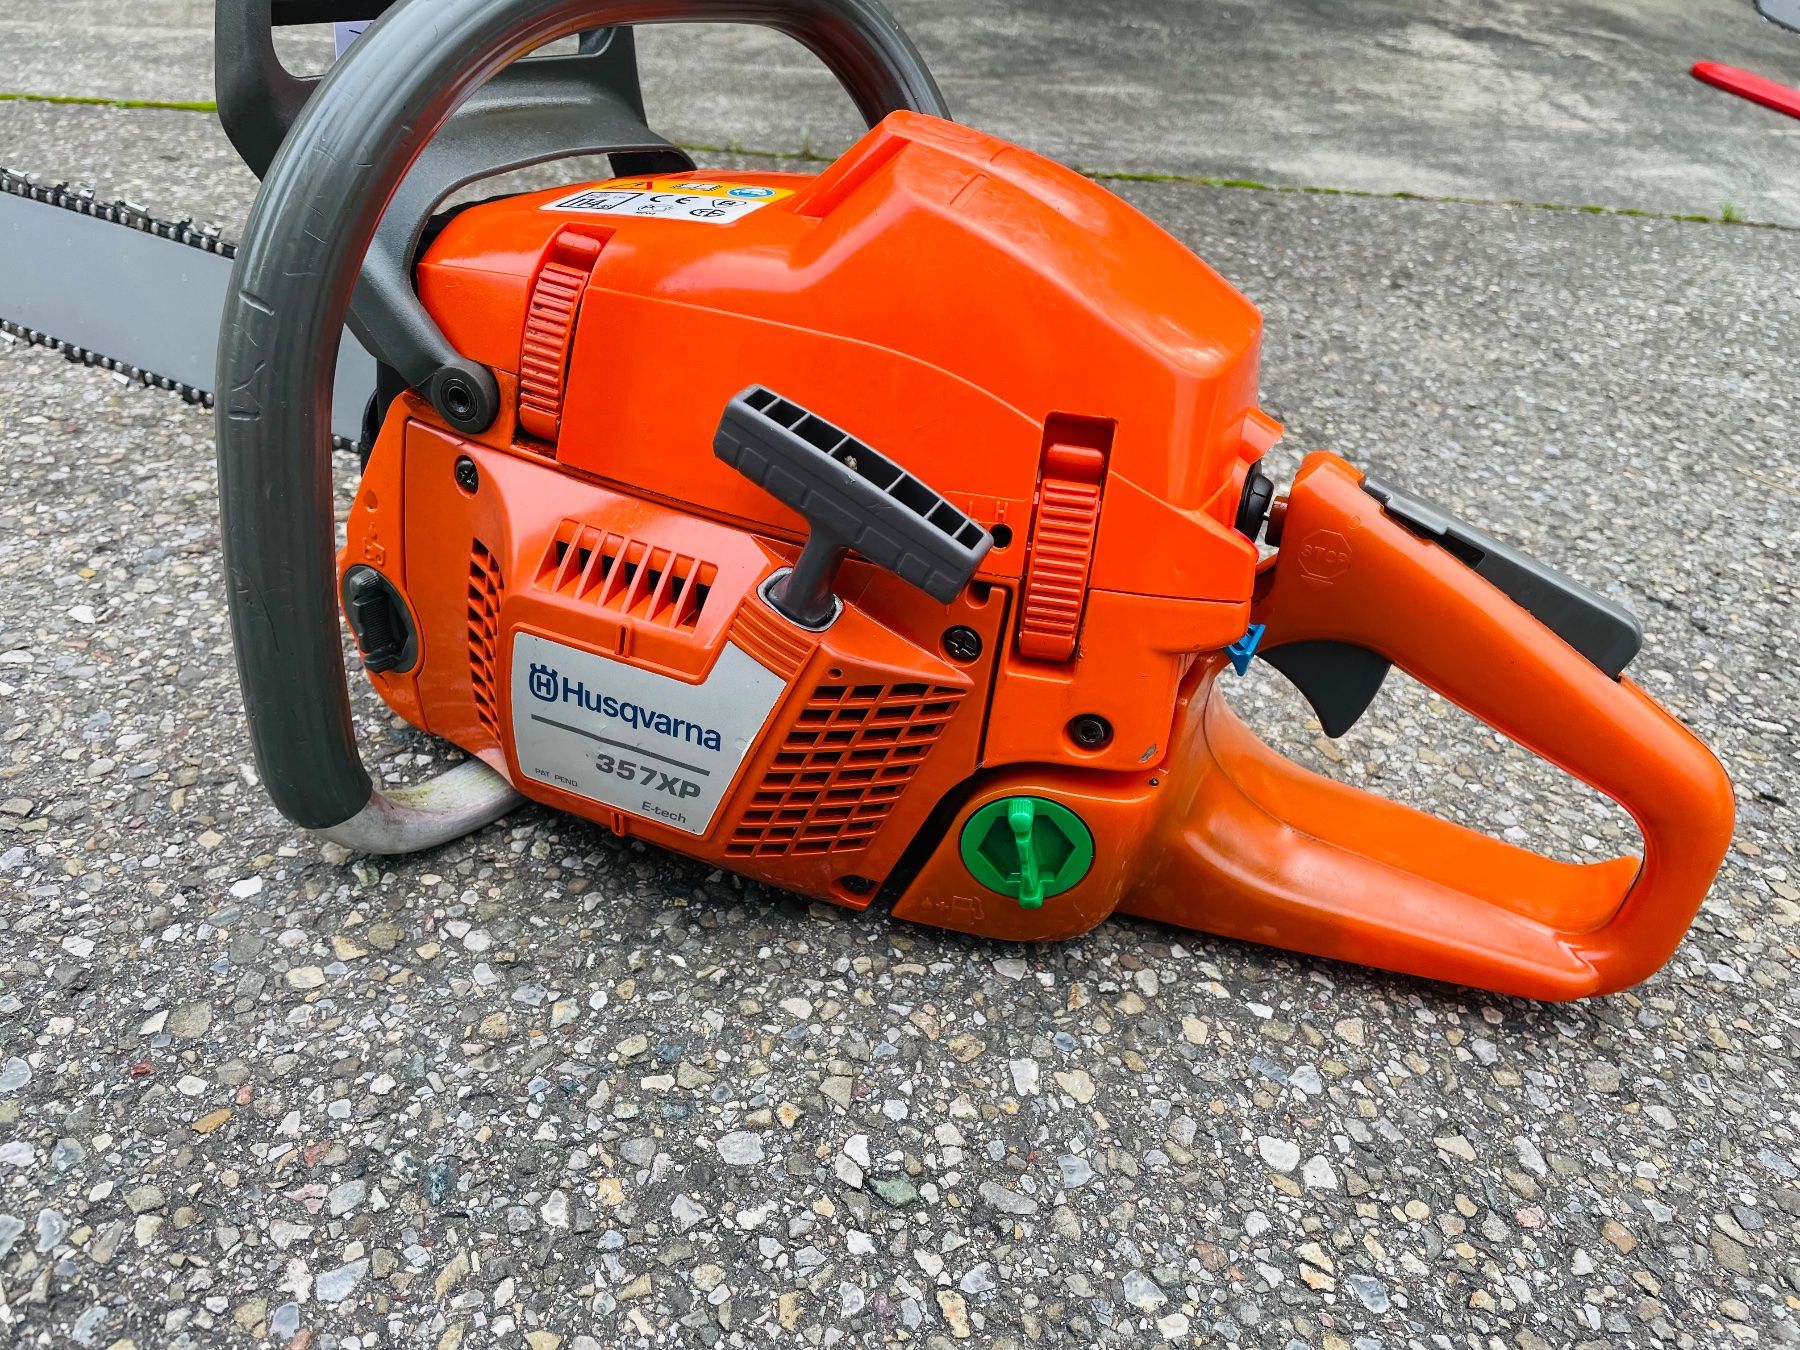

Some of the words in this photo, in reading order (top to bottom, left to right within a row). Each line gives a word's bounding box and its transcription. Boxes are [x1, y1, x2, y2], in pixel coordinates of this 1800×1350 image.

[994, 500, 1009, 522] H
[1301, 544, 1349, 564] STOP
[563, 677, 721, 752] Husqvarna
[535, 767, 550, 778] PAT
[595, 753, 701, 799] 357XP
[641, 801, 687, 824] E-tech
